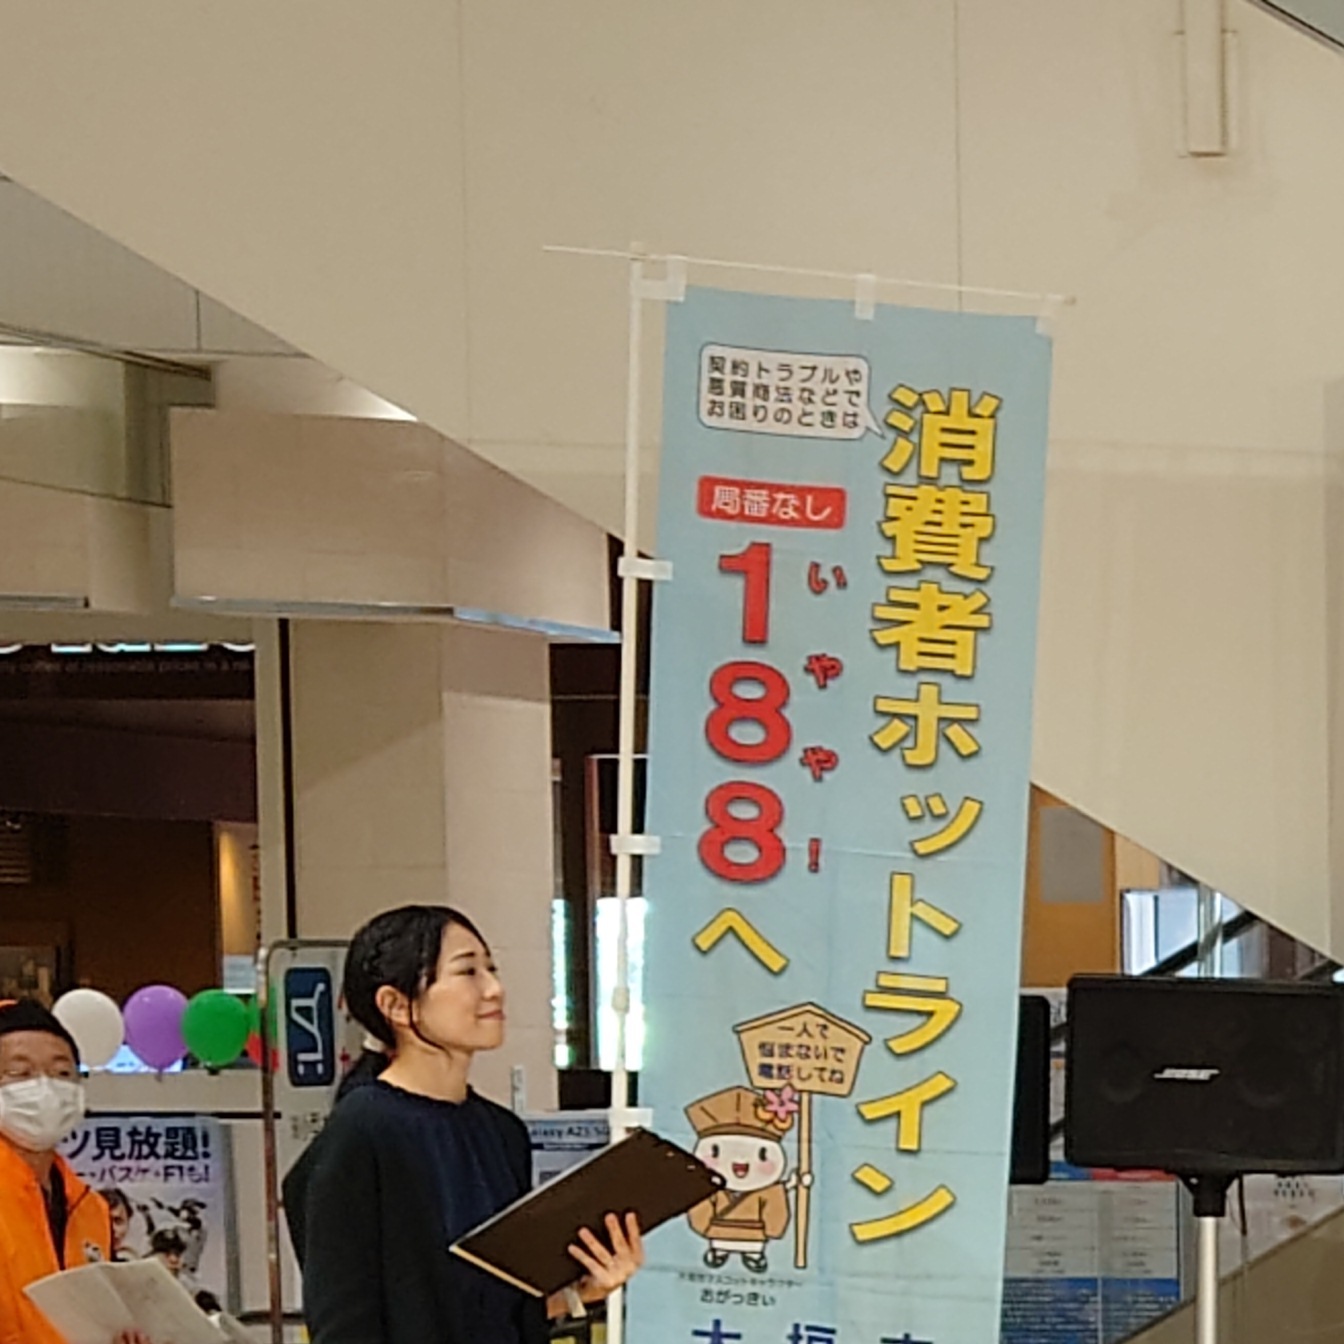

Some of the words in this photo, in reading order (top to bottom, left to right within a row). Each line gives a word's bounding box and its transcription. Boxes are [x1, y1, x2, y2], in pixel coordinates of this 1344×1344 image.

[708, 355, 862, 386] 契約トラブルや
[707, 377, 861, 407] 悪質商法などで
[706, 400, 860, 429] お困りのときは
[711, 485, 832, 521] 局番なし
[849, 384, 1003, 1245] 消費者ホットライン
[777, 1021, 830, 1040] 一人で
[758, 1062, 846, 1085] 電話してね
